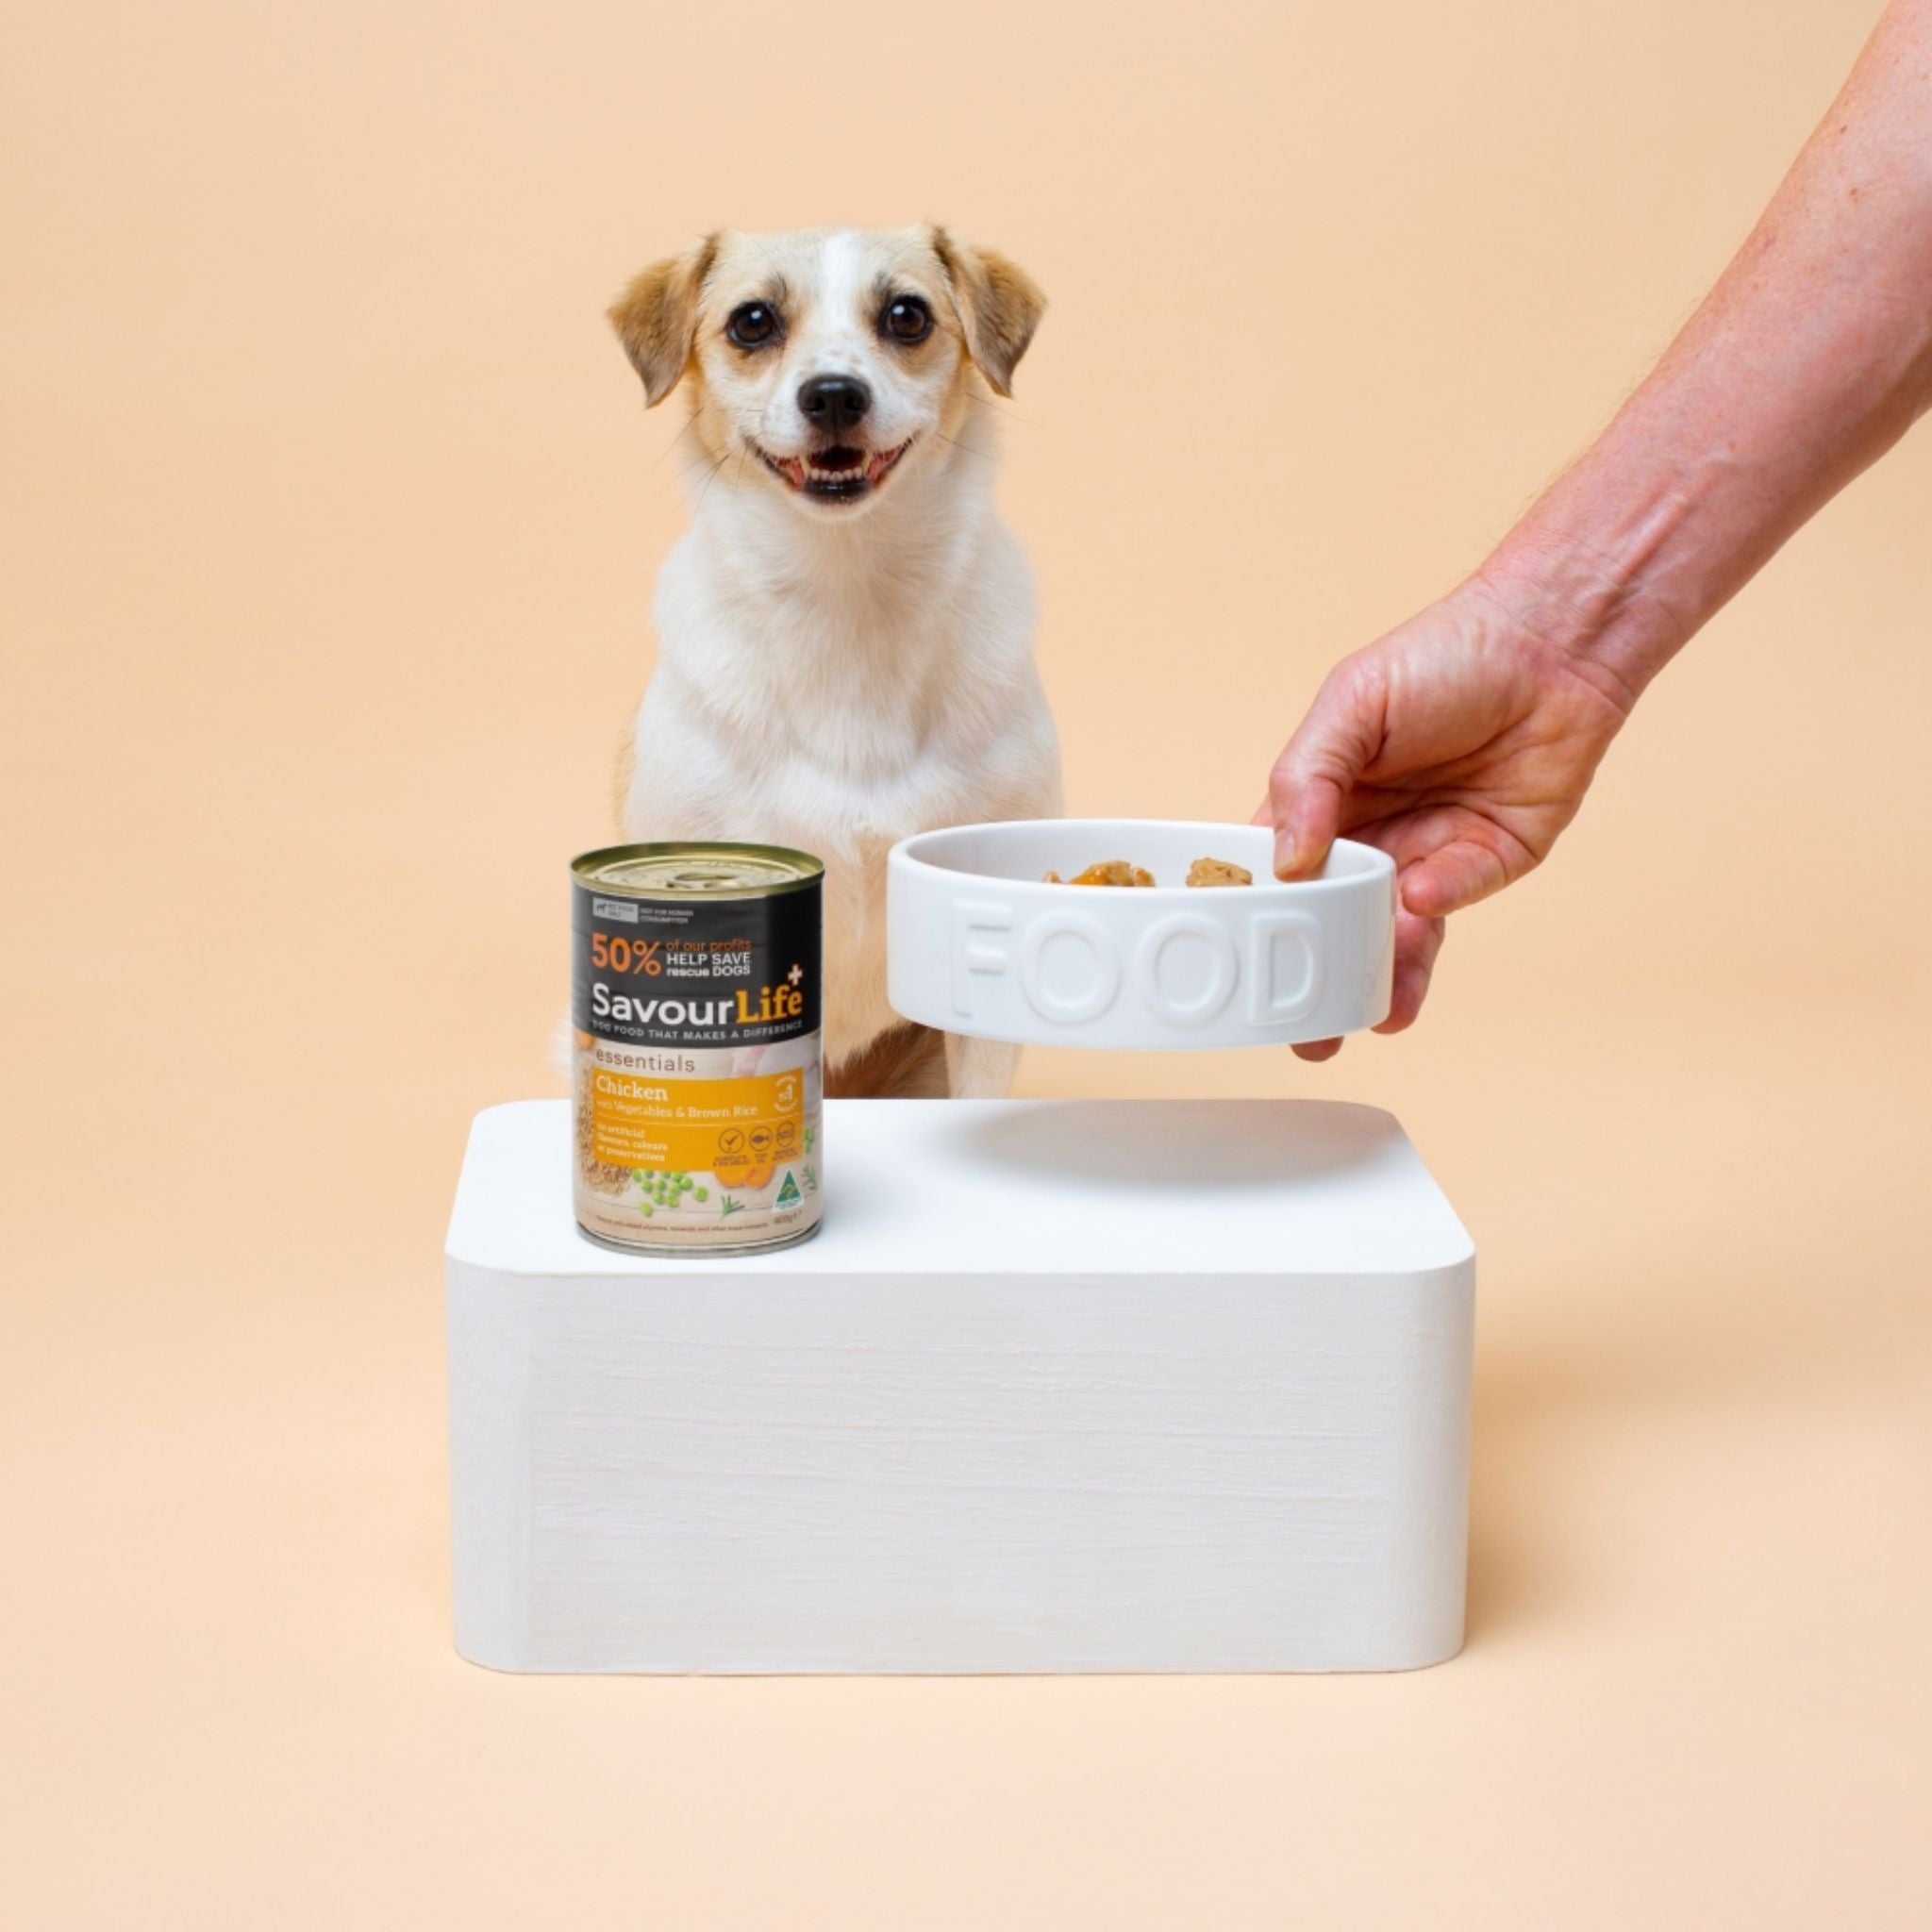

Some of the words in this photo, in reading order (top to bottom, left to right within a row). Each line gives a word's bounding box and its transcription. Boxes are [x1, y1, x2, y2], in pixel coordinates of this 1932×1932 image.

[591, 932, 661, 975] 50%
[666, 940, 679, 951] of
[683, 942, 705, 951] our
[709, 939, 751, 955] profits
[666, 953, 708, 965] HELP
[711, 952, 751, 965] SAVE
[951, 897, 1324, 1028] FOOD
[666, 967, 709, 977] rescue
[712, 965, 751, 976] DOGS
[591, 982, 803, 1025] SavourLife
[614, 1025, 644, 1037] FOOD
[648, 1029, 679, 1040] THAT
[683, 1031, 726, 1041] MAKES
[731, 1030, 740, 1039] A
[743, 1020, 803, 1038] DIFFERENCE
[596, 1049, 695, 1073] essentials
[596, 1075, 669, 1102] Chicken
[615, 1101, 673, 1118] Vegetables
[675, 1107, 685, 1117] &
[688, 1107, 730, 1118] Brown
[733, 1106, 758, 1117] Rice
[607, 1147, 666, 1162] preservatives
